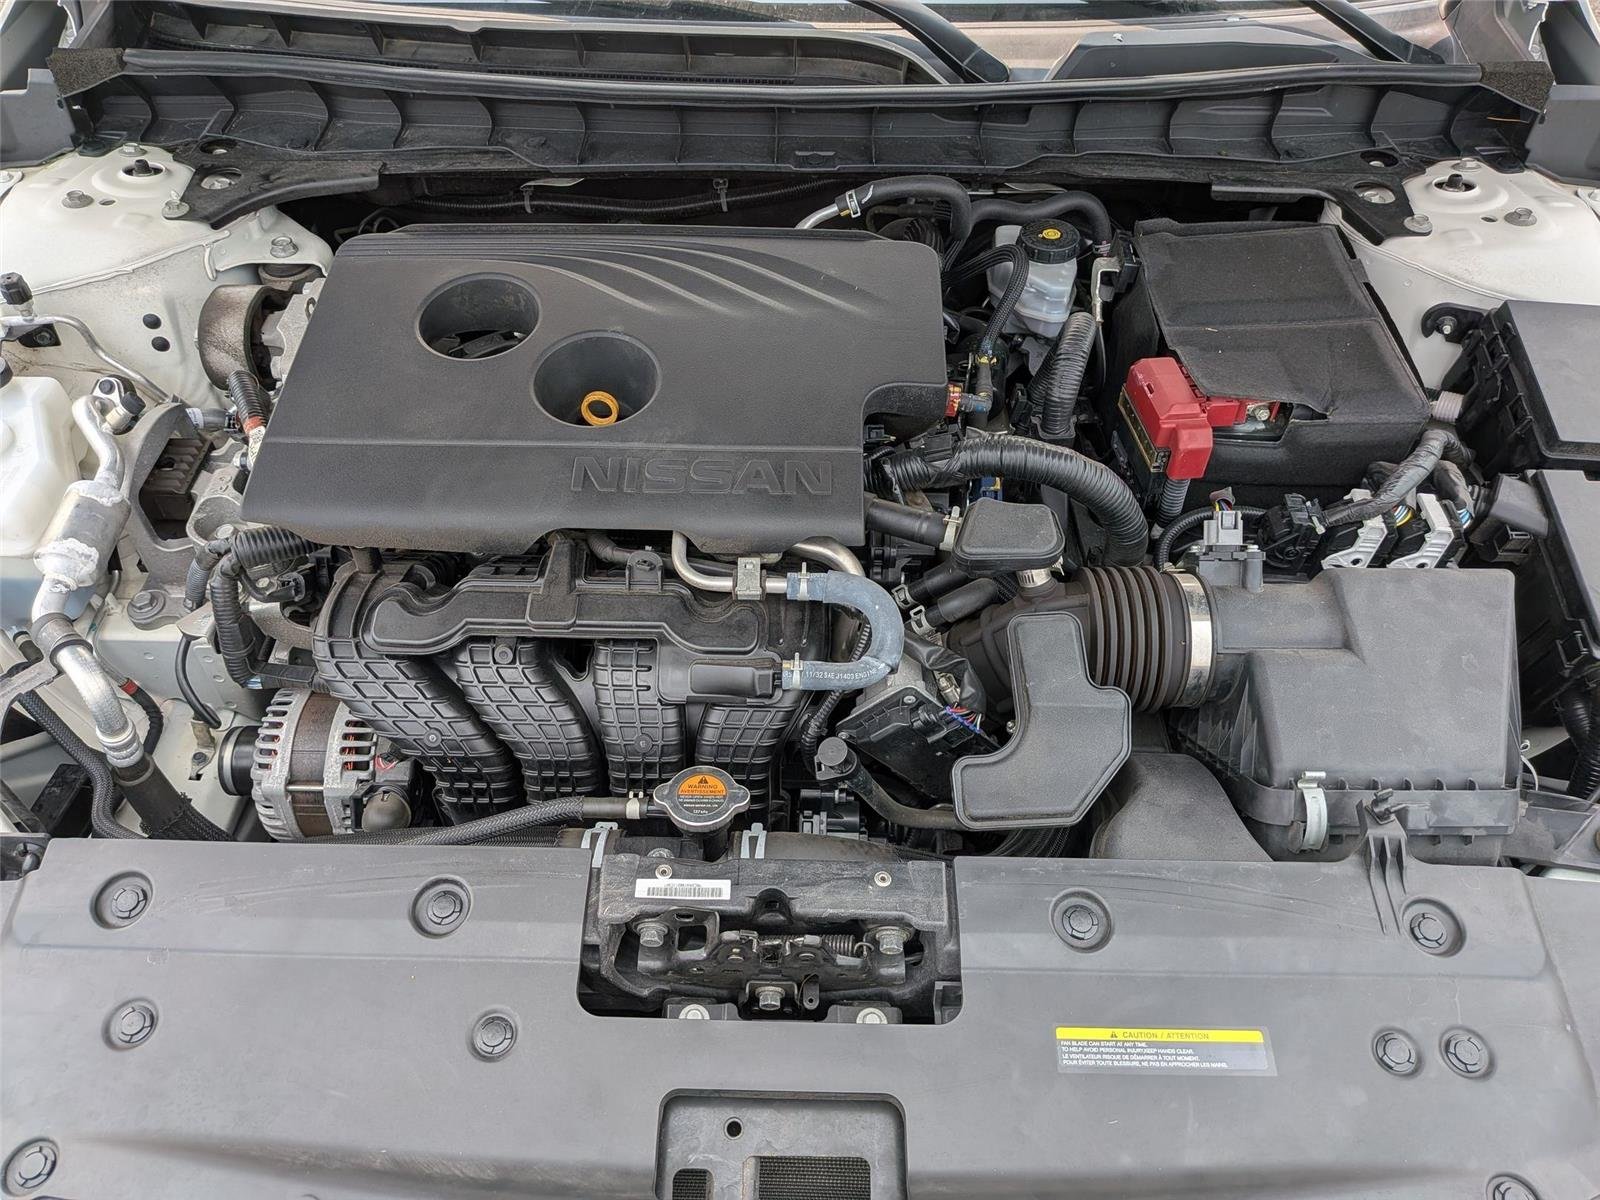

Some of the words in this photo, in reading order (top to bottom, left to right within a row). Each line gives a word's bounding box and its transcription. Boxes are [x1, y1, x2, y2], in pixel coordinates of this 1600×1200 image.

[571, 456, 832, 496] NISSAN
[824, 671, 835, 679] SAE
[1122, 1031, 1158, 1039] CAUTION
[1166, 1032, 1209, 1040] ATTENTION
